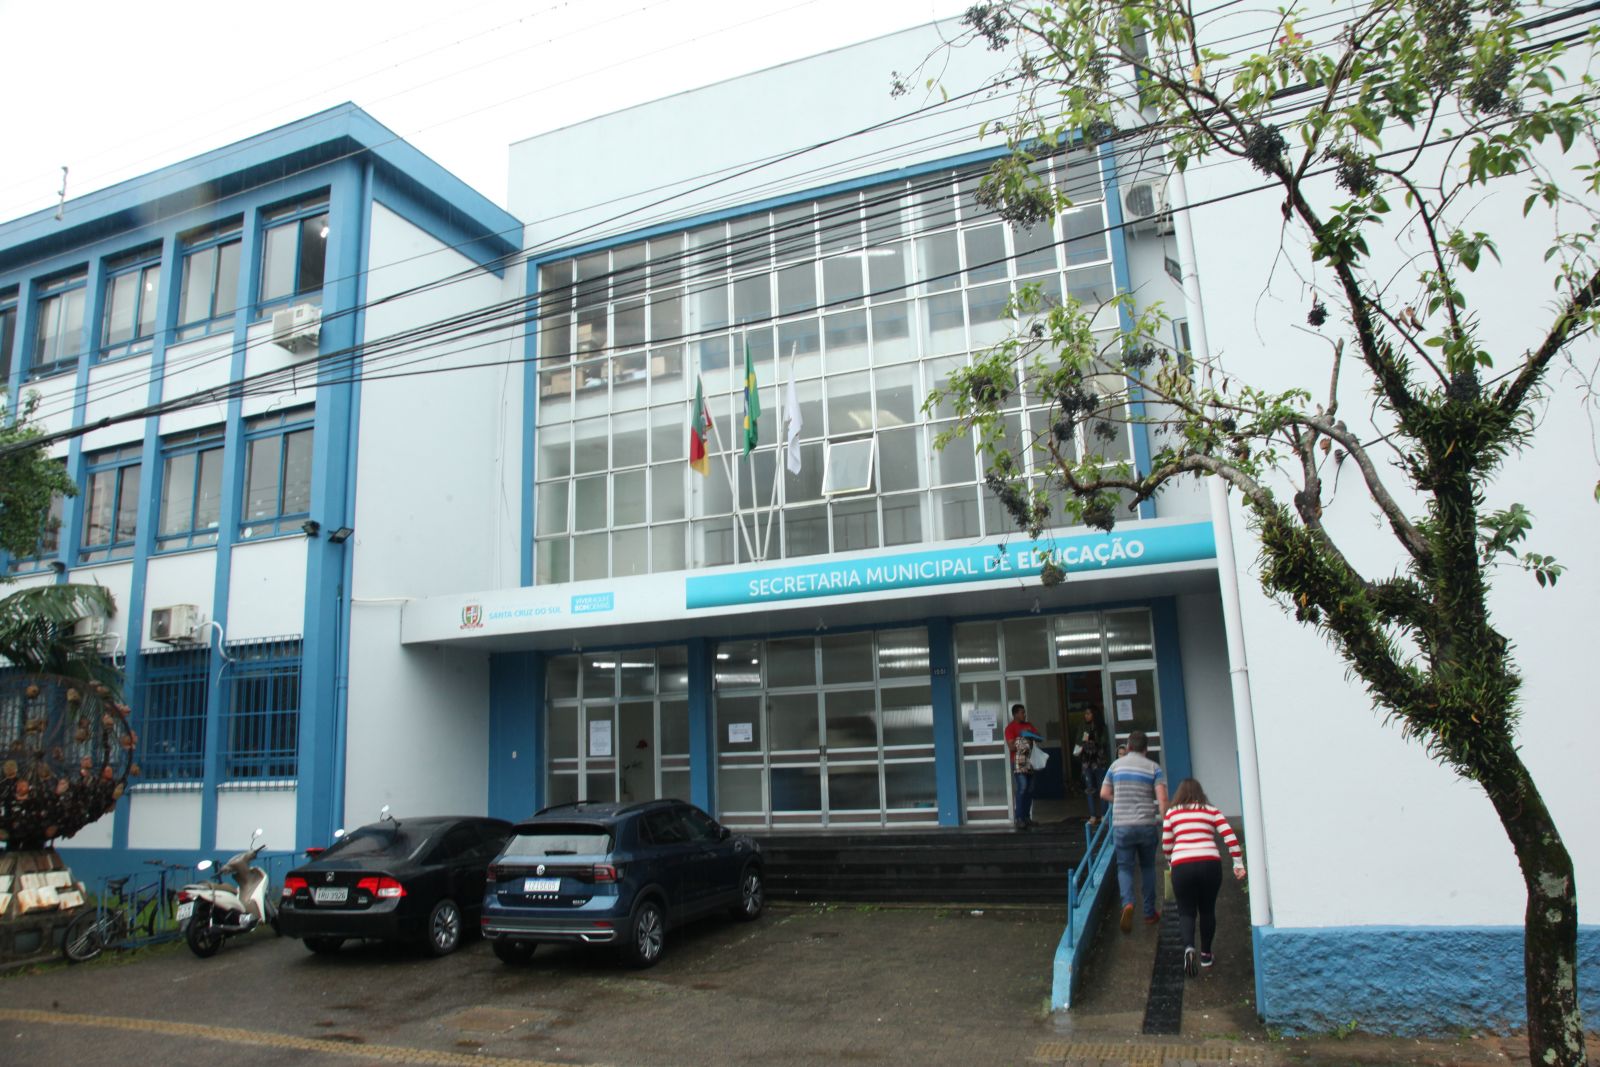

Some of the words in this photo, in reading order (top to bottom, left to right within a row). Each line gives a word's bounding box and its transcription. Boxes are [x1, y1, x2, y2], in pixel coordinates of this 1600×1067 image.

[749, 569, 861, 597] SECRETARIA
[866, 557, 978, 585] MUNICIPAL
[984, 553, 1012, 573] DE
[1017, 537, 1144, 570] EDUCAÇÃO
[489, 610, 513, 620] SANTA
[514, 608, 533, 617] CRUZ
[535, 607, 546, 615] DO
[547, 606, 561, 615] SUL
